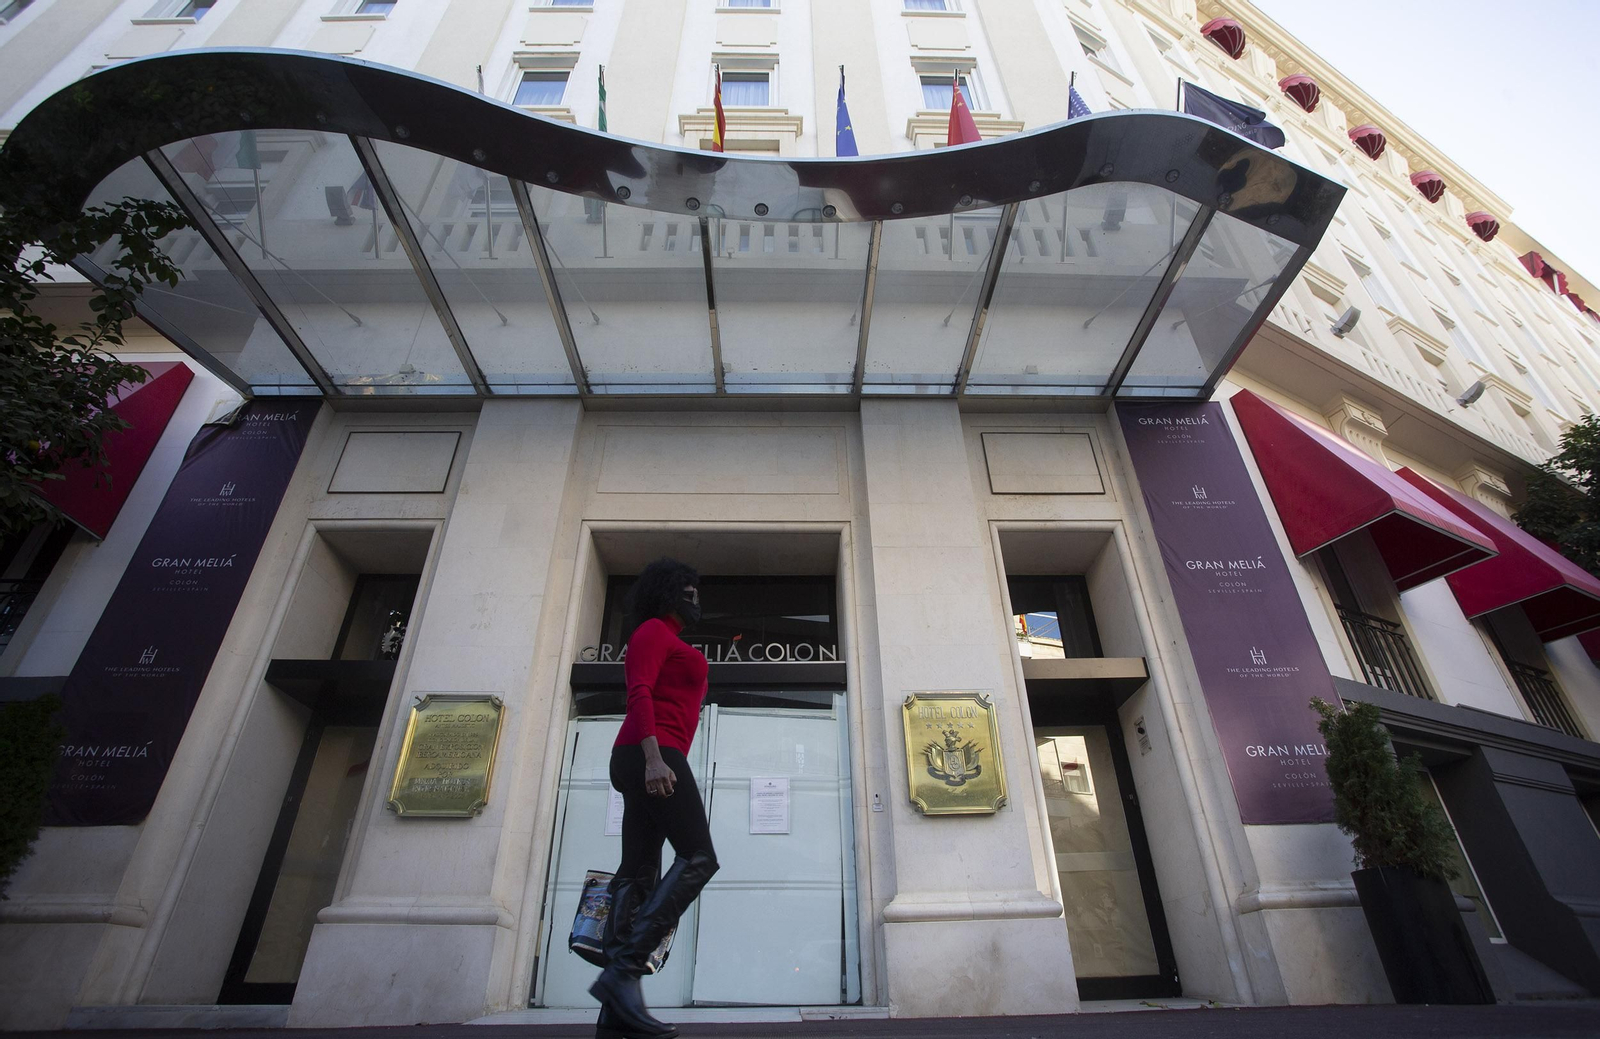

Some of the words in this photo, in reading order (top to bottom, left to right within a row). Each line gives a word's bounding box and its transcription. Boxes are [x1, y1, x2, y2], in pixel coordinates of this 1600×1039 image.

[263, 410, 300, 421] MELIÁ
[1138, 417, 1173, 425] GRAN
[1176, 414, 1210, 425] MELIÁ
[152, 557, 192, 568] GRAN
[194, 554, 237, 568] MELIÁ
[1186, 560, 1224, 570] GRAN
[1228, 556, 1266, 570] MELIÁ
[579, 642, 629, 662] GRA
[748, 642, 837, 662] COLON
[424, 714, 456, 722] HOTEL
[457, 714, 490, 722] COLON
[918, 706, 946, 719] HOTEL
[950, 705, 978, 719] COLON
[101, 740, 154, 758] MELIÁ
[1245, 745, 1290, 758] GRAN
[1294, 743, 1332, 757] MELI
[1280, 758, 1311, 766] HOTEL
